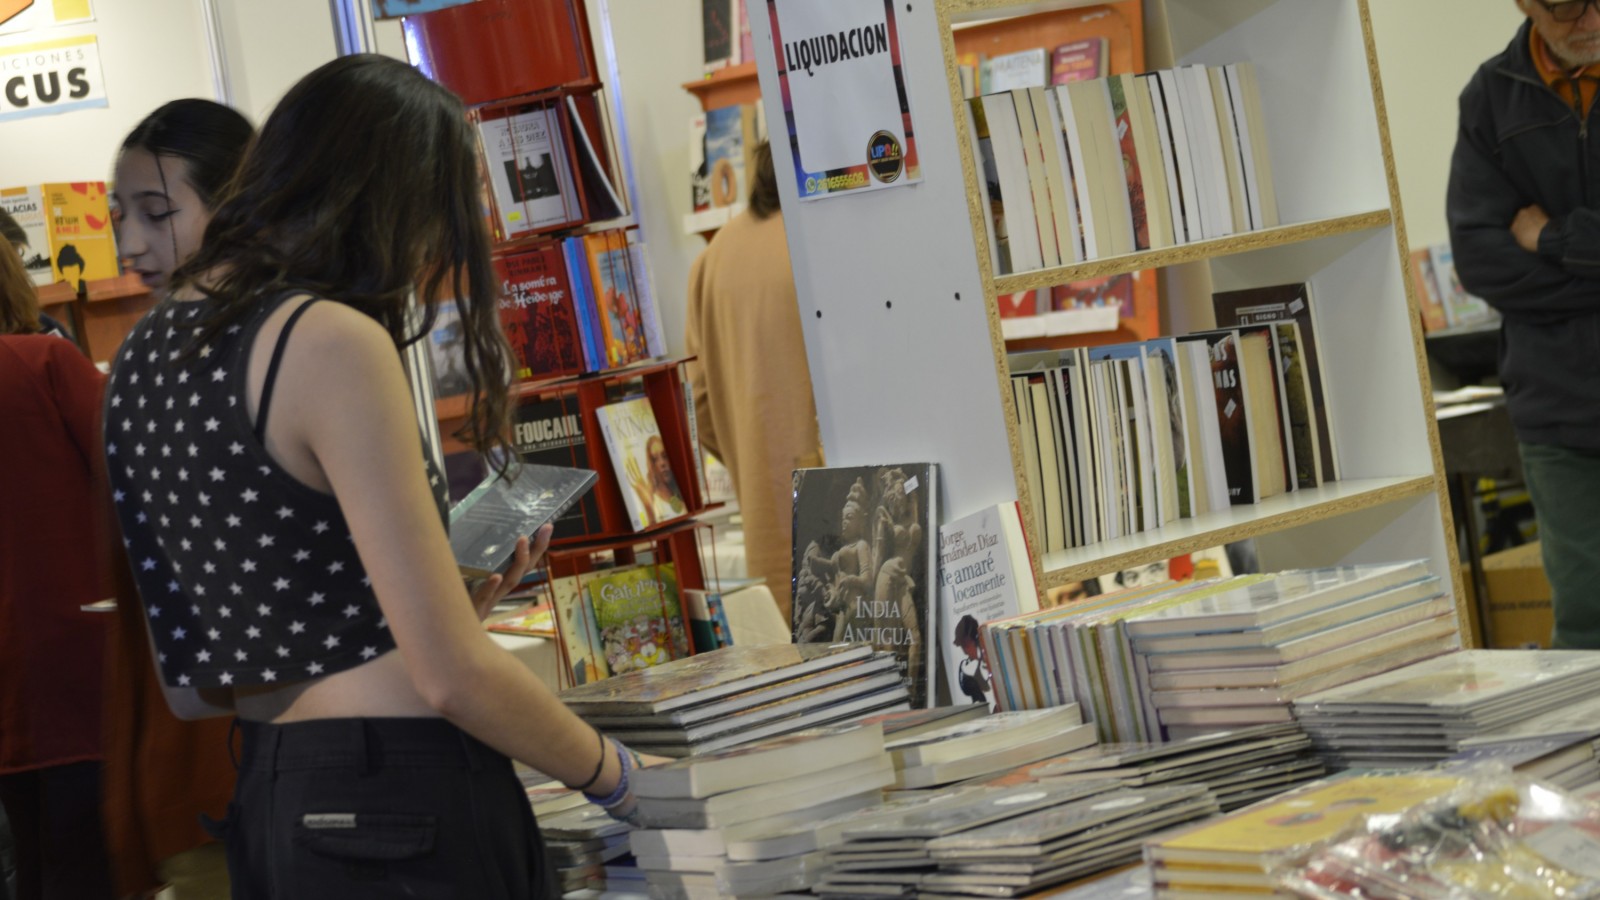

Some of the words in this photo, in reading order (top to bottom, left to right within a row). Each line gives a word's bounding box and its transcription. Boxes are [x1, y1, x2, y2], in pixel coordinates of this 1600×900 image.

[785, 22, 888, 77] LIQUIDACION
[502, 279, 518, 296] La
[514, 413, 582, 446] FOUCAUL
[613, 410, 656, 441] KING
[940, 530, 964, 549] Jorge
[977, 533, 999, 551] Díaz
[939, 567, 953, 588] Te
[954, 550, 995, 585] amaré
[951, 573, 1006, 604] locamente
[855, 595, 901, 619] INDIA
[842, 622, 916, 646] ANTIGUA
